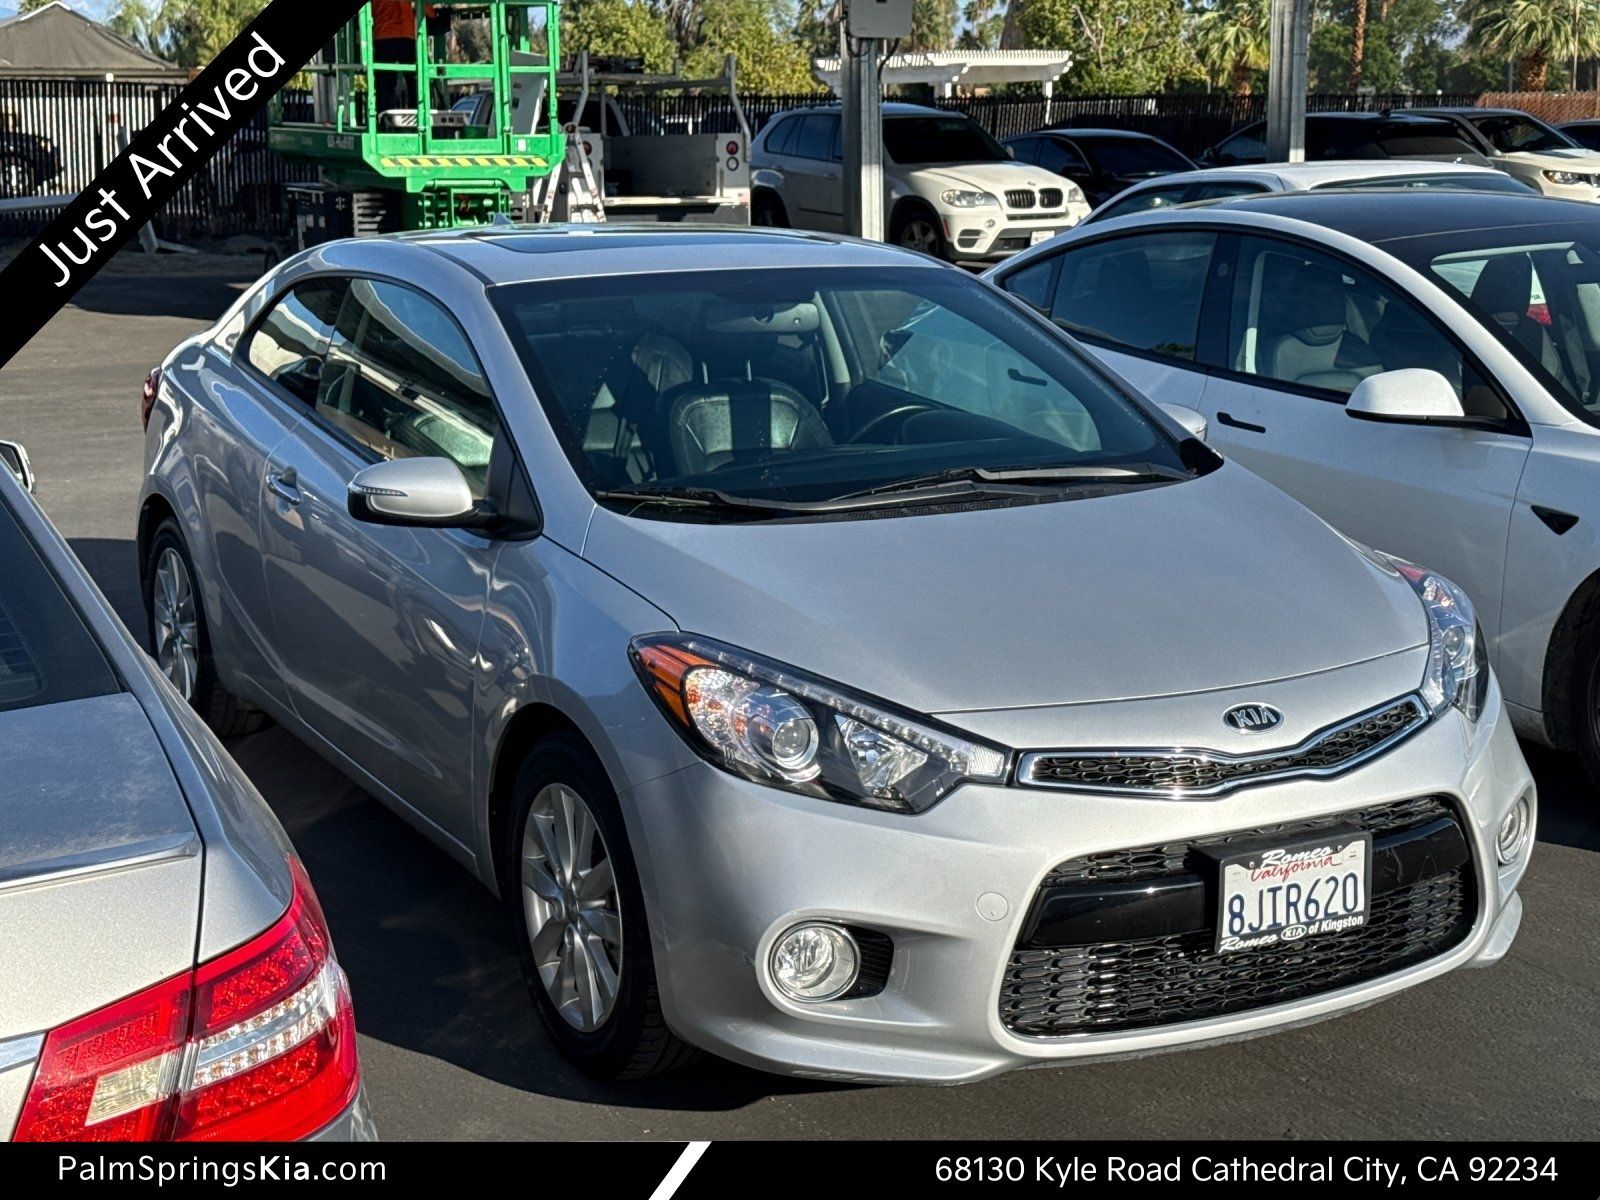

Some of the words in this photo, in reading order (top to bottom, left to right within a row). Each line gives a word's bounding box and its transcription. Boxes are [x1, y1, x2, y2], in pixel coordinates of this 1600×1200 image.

[1231, 707, 1277, 728] KIA
[1251, 855, 1342, 882] California
[1261, 846, 1333, 868] Romeo
[1228, 872, 1358, 936] 8JIR620
[1218, 935, 1279, 954] Romeo
[1308, 924, 1320, 935] of
[1321, 915, 1364, 932] Kingston
